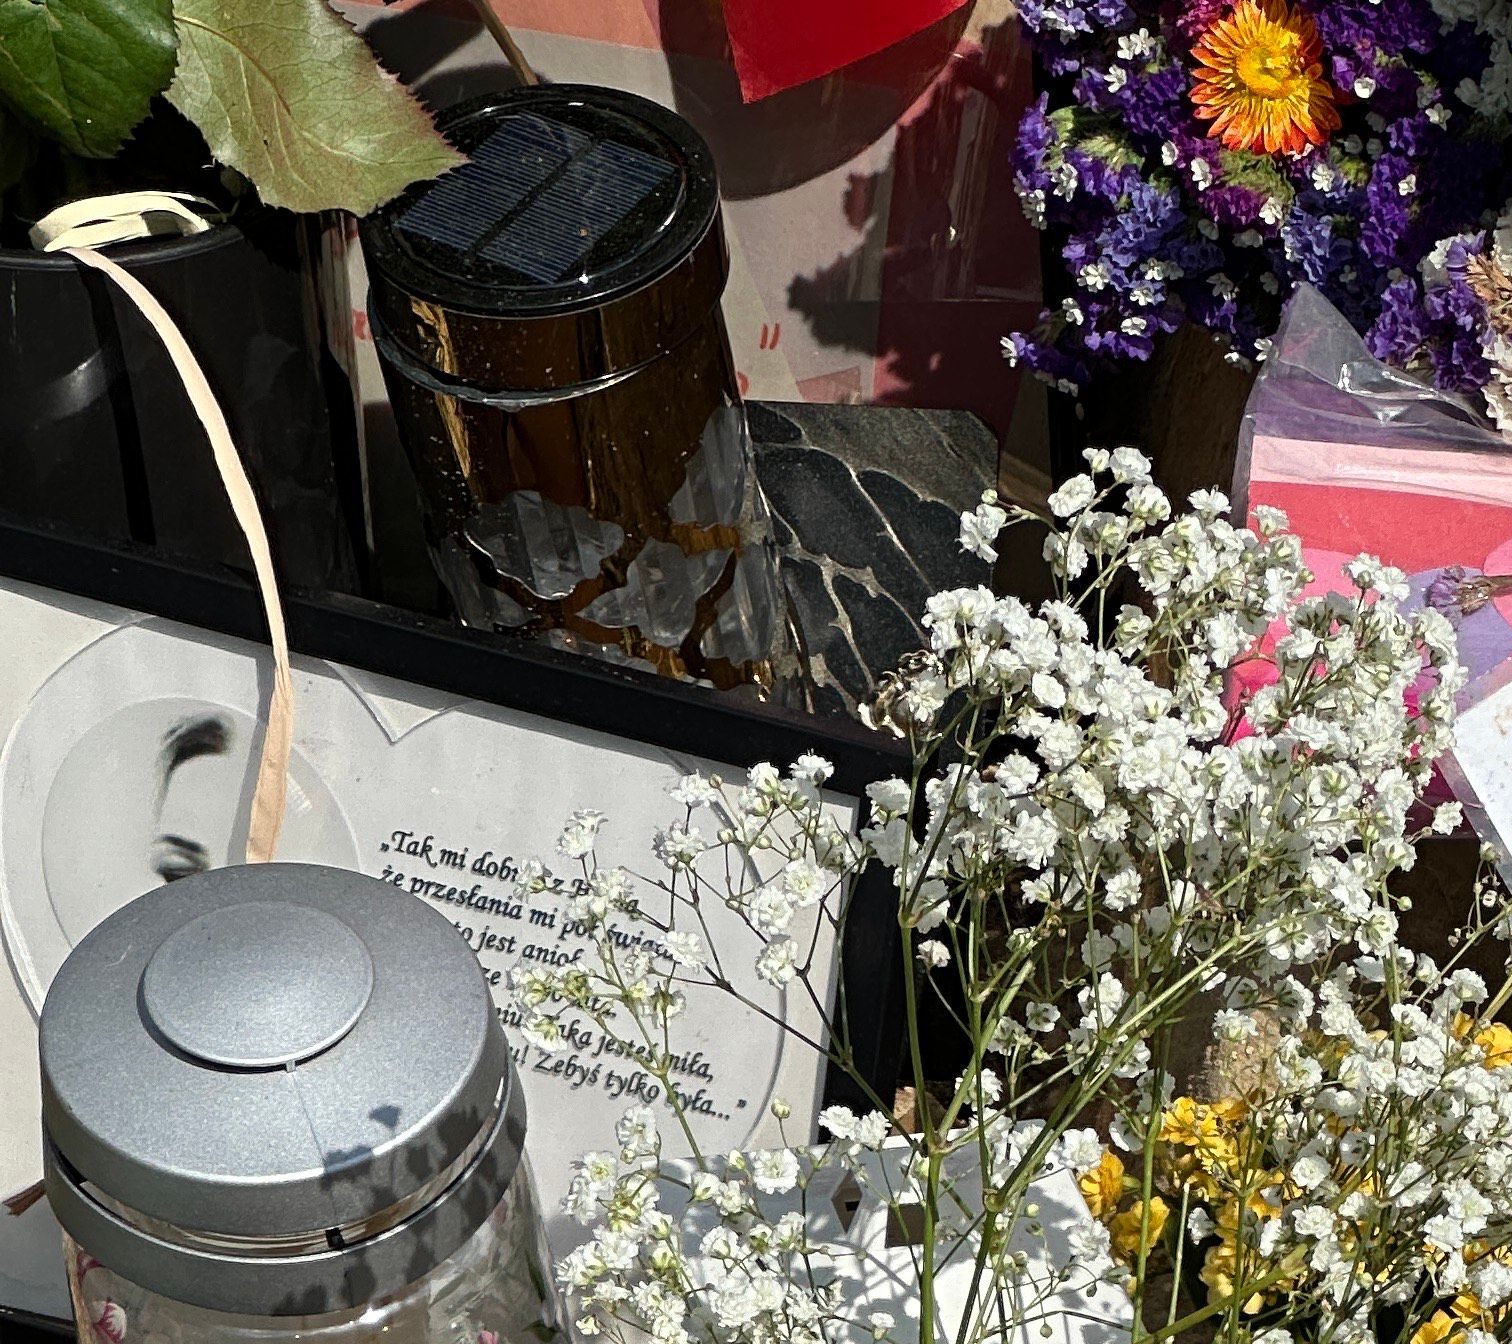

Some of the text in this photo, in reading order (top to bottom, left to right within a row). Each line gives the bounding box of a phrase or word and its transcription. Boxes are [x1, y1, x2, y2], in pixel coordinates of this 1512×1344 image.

[438, 847, 469, 871] mi
[410, 876, 523, 921] przesłania
[529, 907, 558, 930] mi
[605, 1072, 660, 1102] tylko
